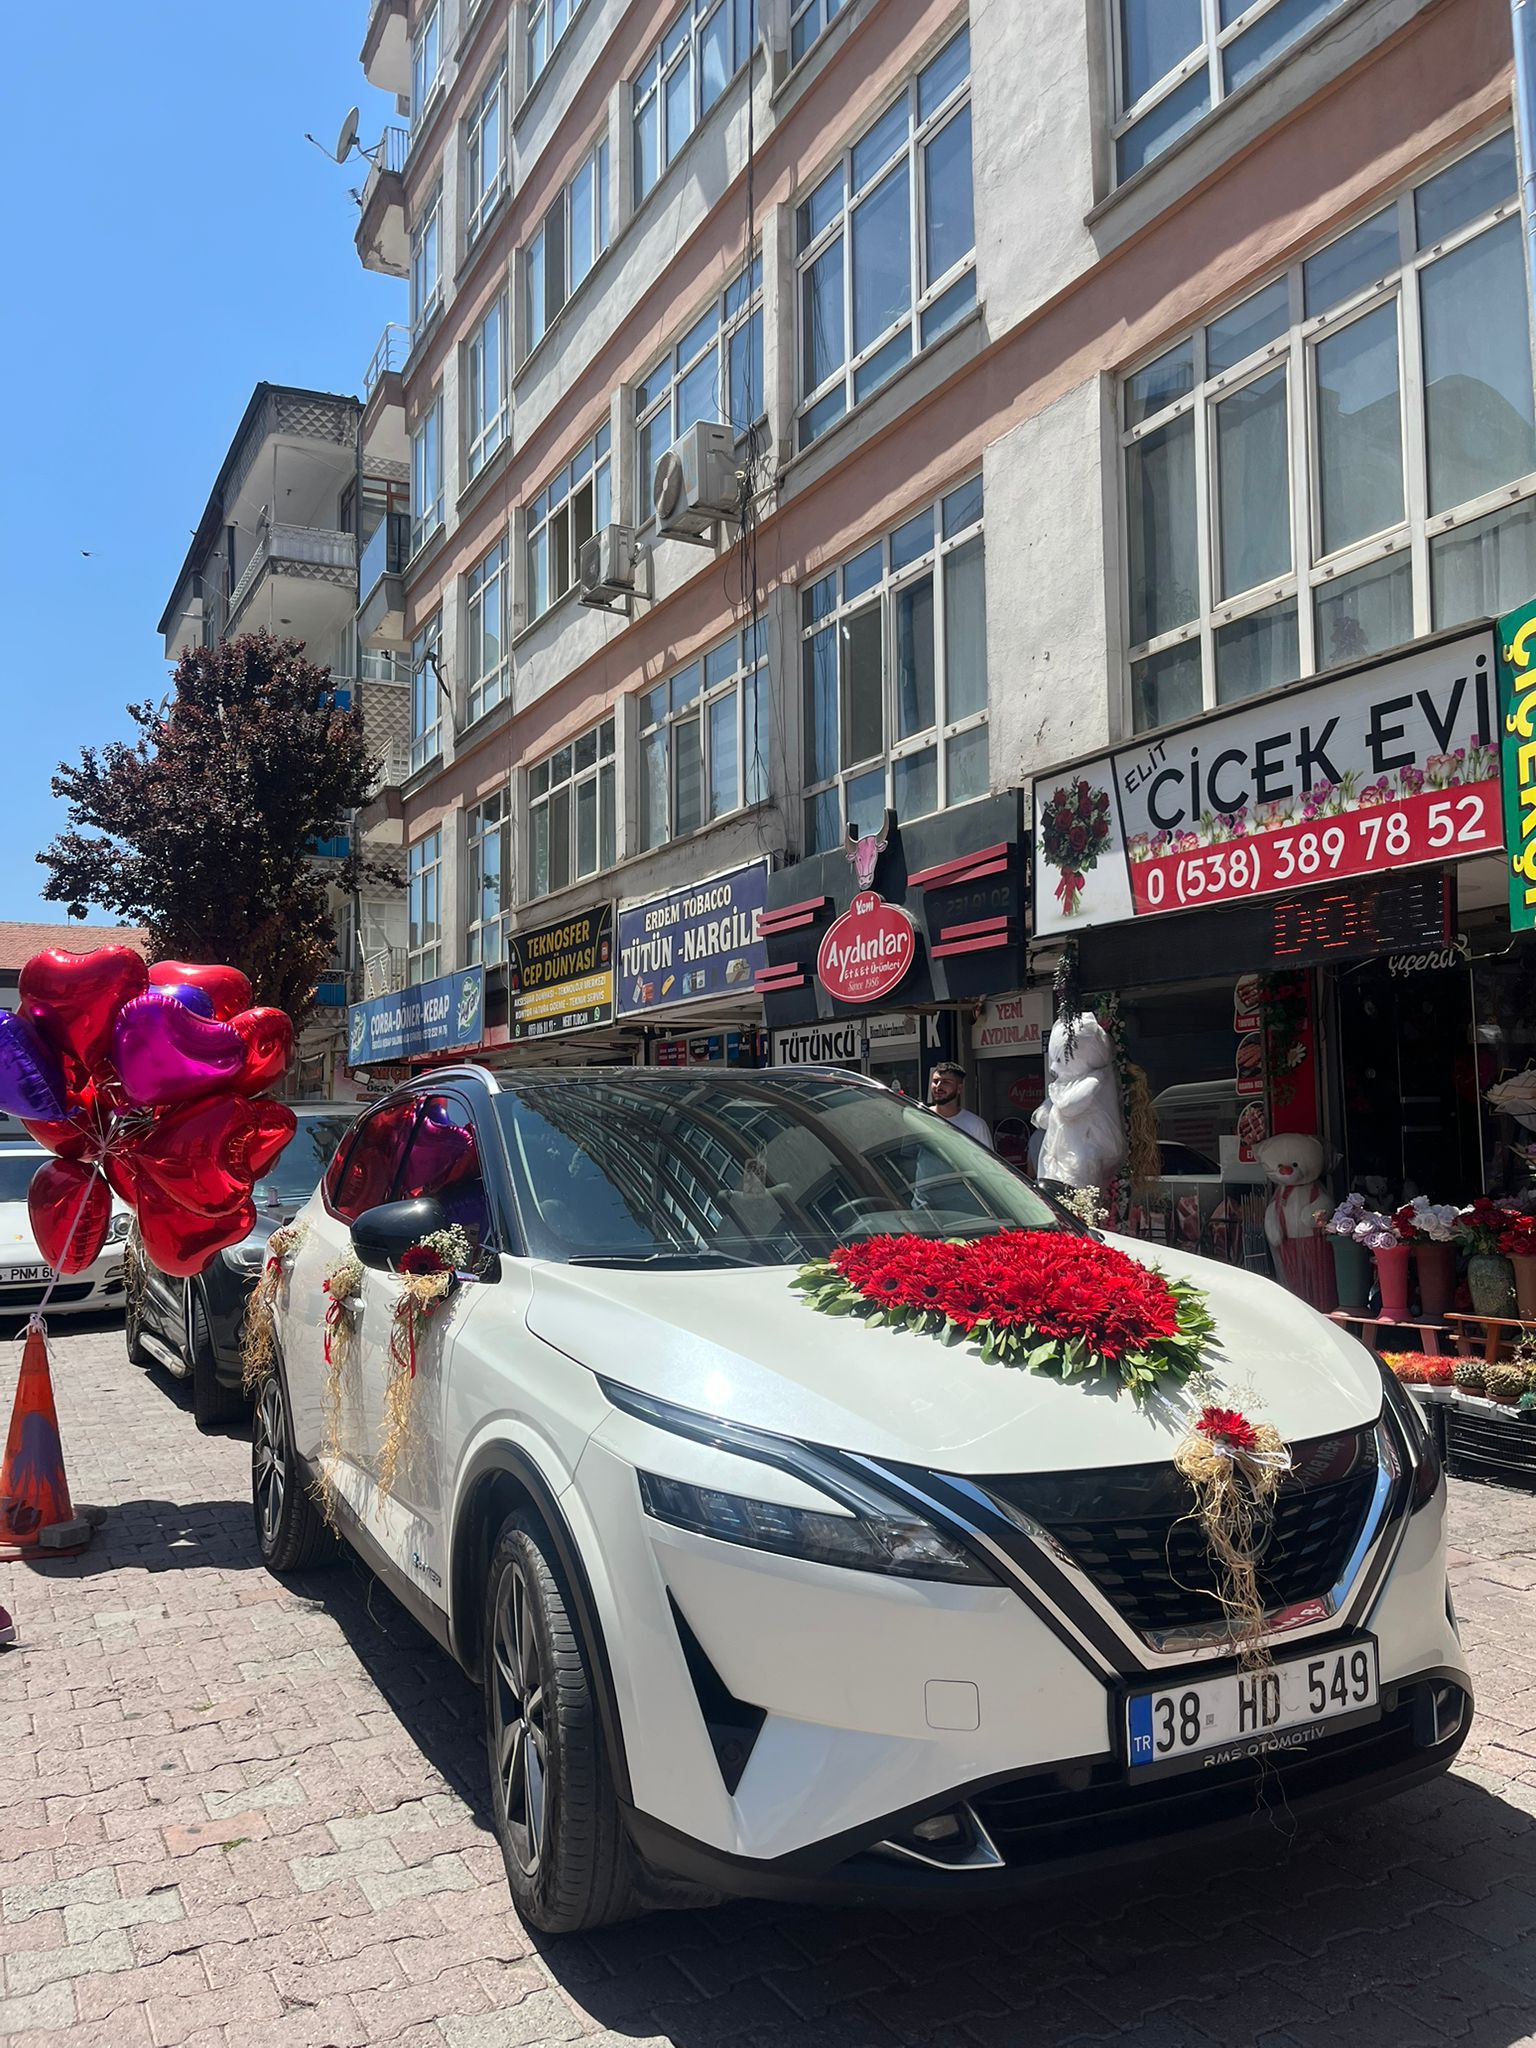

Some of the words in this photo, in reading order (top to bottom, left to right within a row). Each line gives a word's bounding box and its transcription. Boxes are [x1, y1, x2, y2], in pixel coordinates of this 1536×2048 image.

[1124, 740, 1166, 794] ELİT
[1147, 715, 1344, 845] ÇİÇEK
[1365, 654, 1491, 774] EVİ
[1147, 868, 1164, 905] 0
[1176, 843, 1261, 904] (538)
[1273, 826, 1345, 880] 389
[1359, 812, 1411, 861] 78
[1428, 795, 1486, 847] 52
[645, 902, 680, 932] ERDEM
[683, 884, 732, 919] TOBACCO
[856, 896, 874, 915] Yeni
[527, 919, 590, 960] TEKNOSFER
[621, 932, 673, 978] TÜTÜN
[826, 928, 908, 983] Aydınlar
[523, 962, 543, 987] CEP
[544, 946, 595, 981] DÜNYASI
[995, 997, 1024, 1020] YENİ
[779, 1024, 855, 1064] TÜTÜNCÜ
[980, 1023, 1041, 1046] AYDINLAR
[11, 1268, 38, 1280] PNM
[1133, 1735, 1151, 1753] TR
[1154, 1691, 1201, 1753] 38
[1238, 1673, 1281, 1733] HD
[1307, 1650, 1369, 1714] 549
[1204, 1747, 1242, 1767] RMS
[1247, 1726, 1325, 1755] OTOMOTİV
